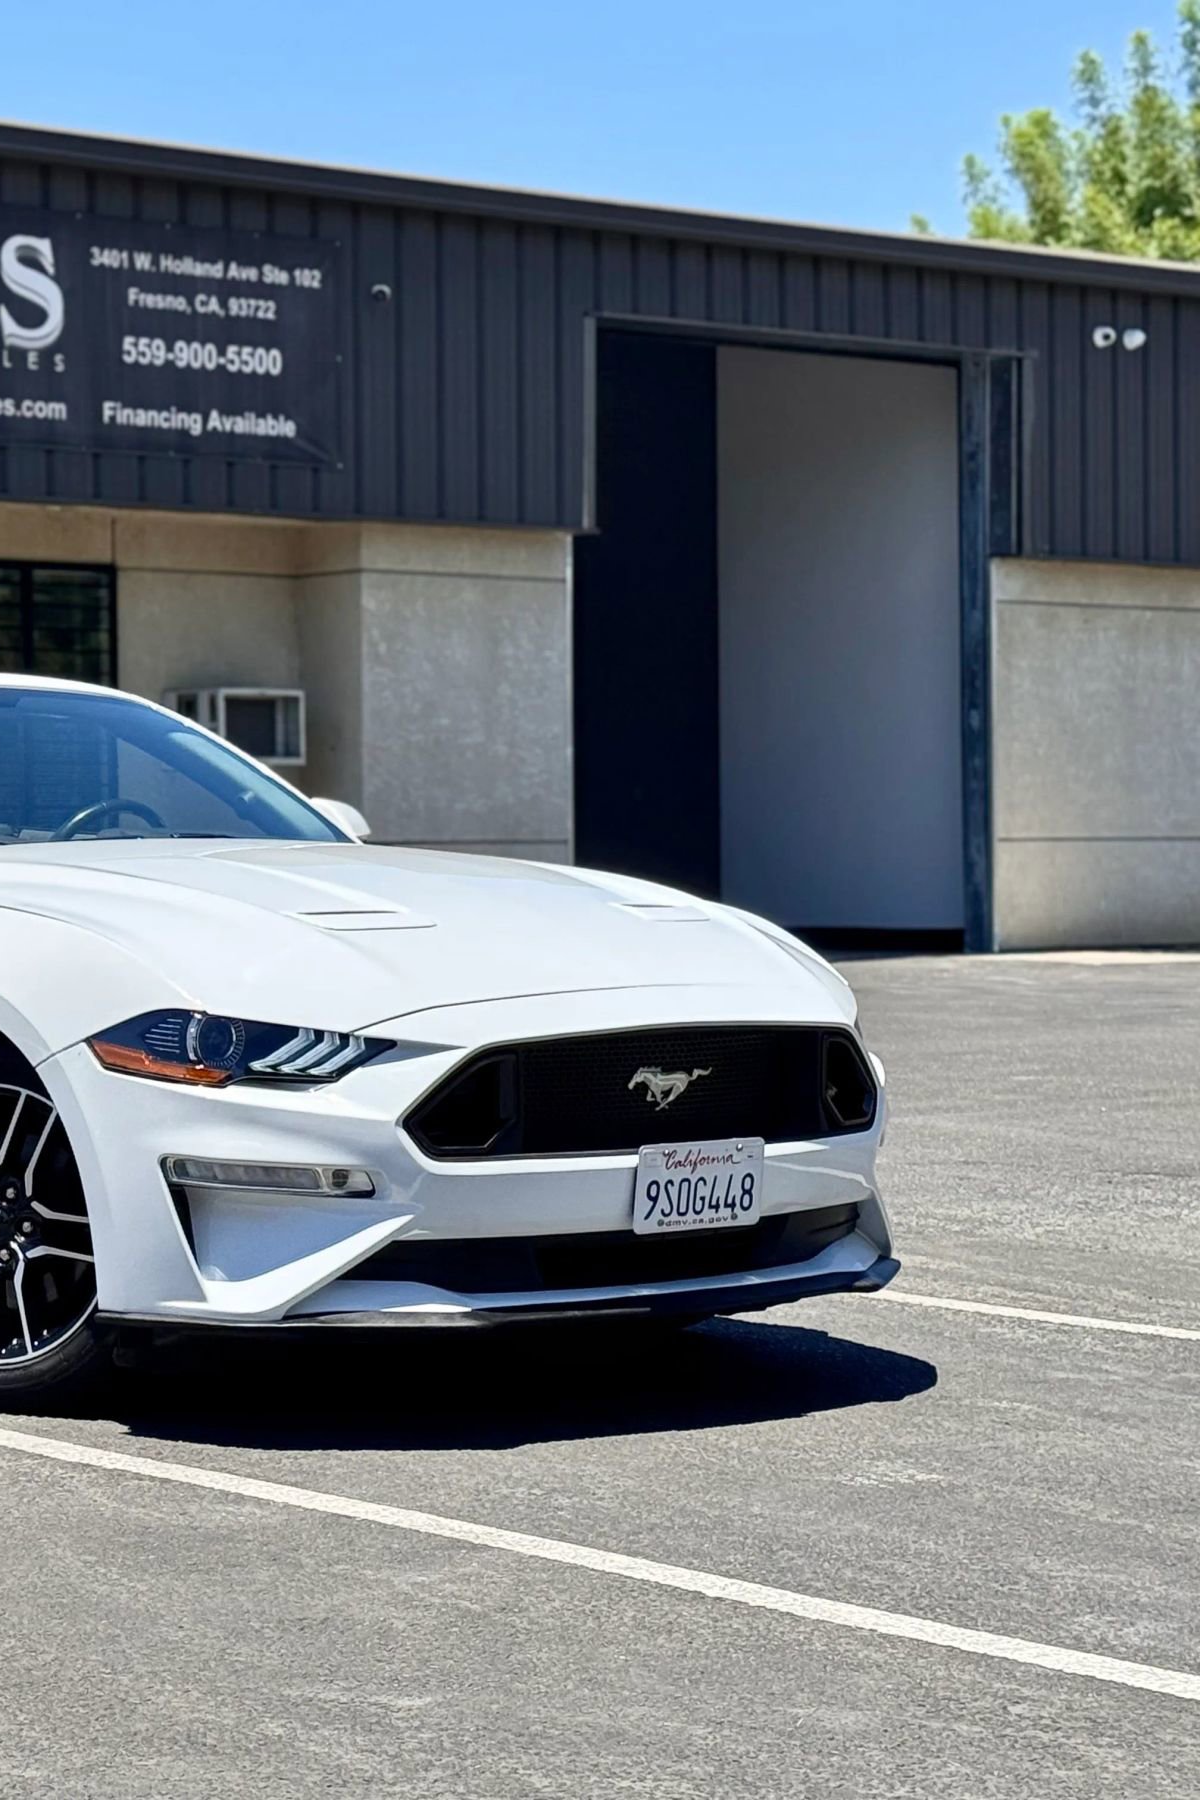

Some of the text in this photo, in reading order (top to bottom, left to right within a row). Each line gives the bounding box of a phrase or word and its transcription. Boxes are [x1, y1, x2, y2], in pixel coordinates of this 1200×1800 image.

[90, 247, 322, 288] 3401 W. Holland Ave Ste 102
[127, 287, 277, 320] Fresno, CA, 93722
[121, 336, 283, 376] 559-900-5500
[102, 402, 297, 439] Financing Available
[665, 1148, 741, 1174] California
